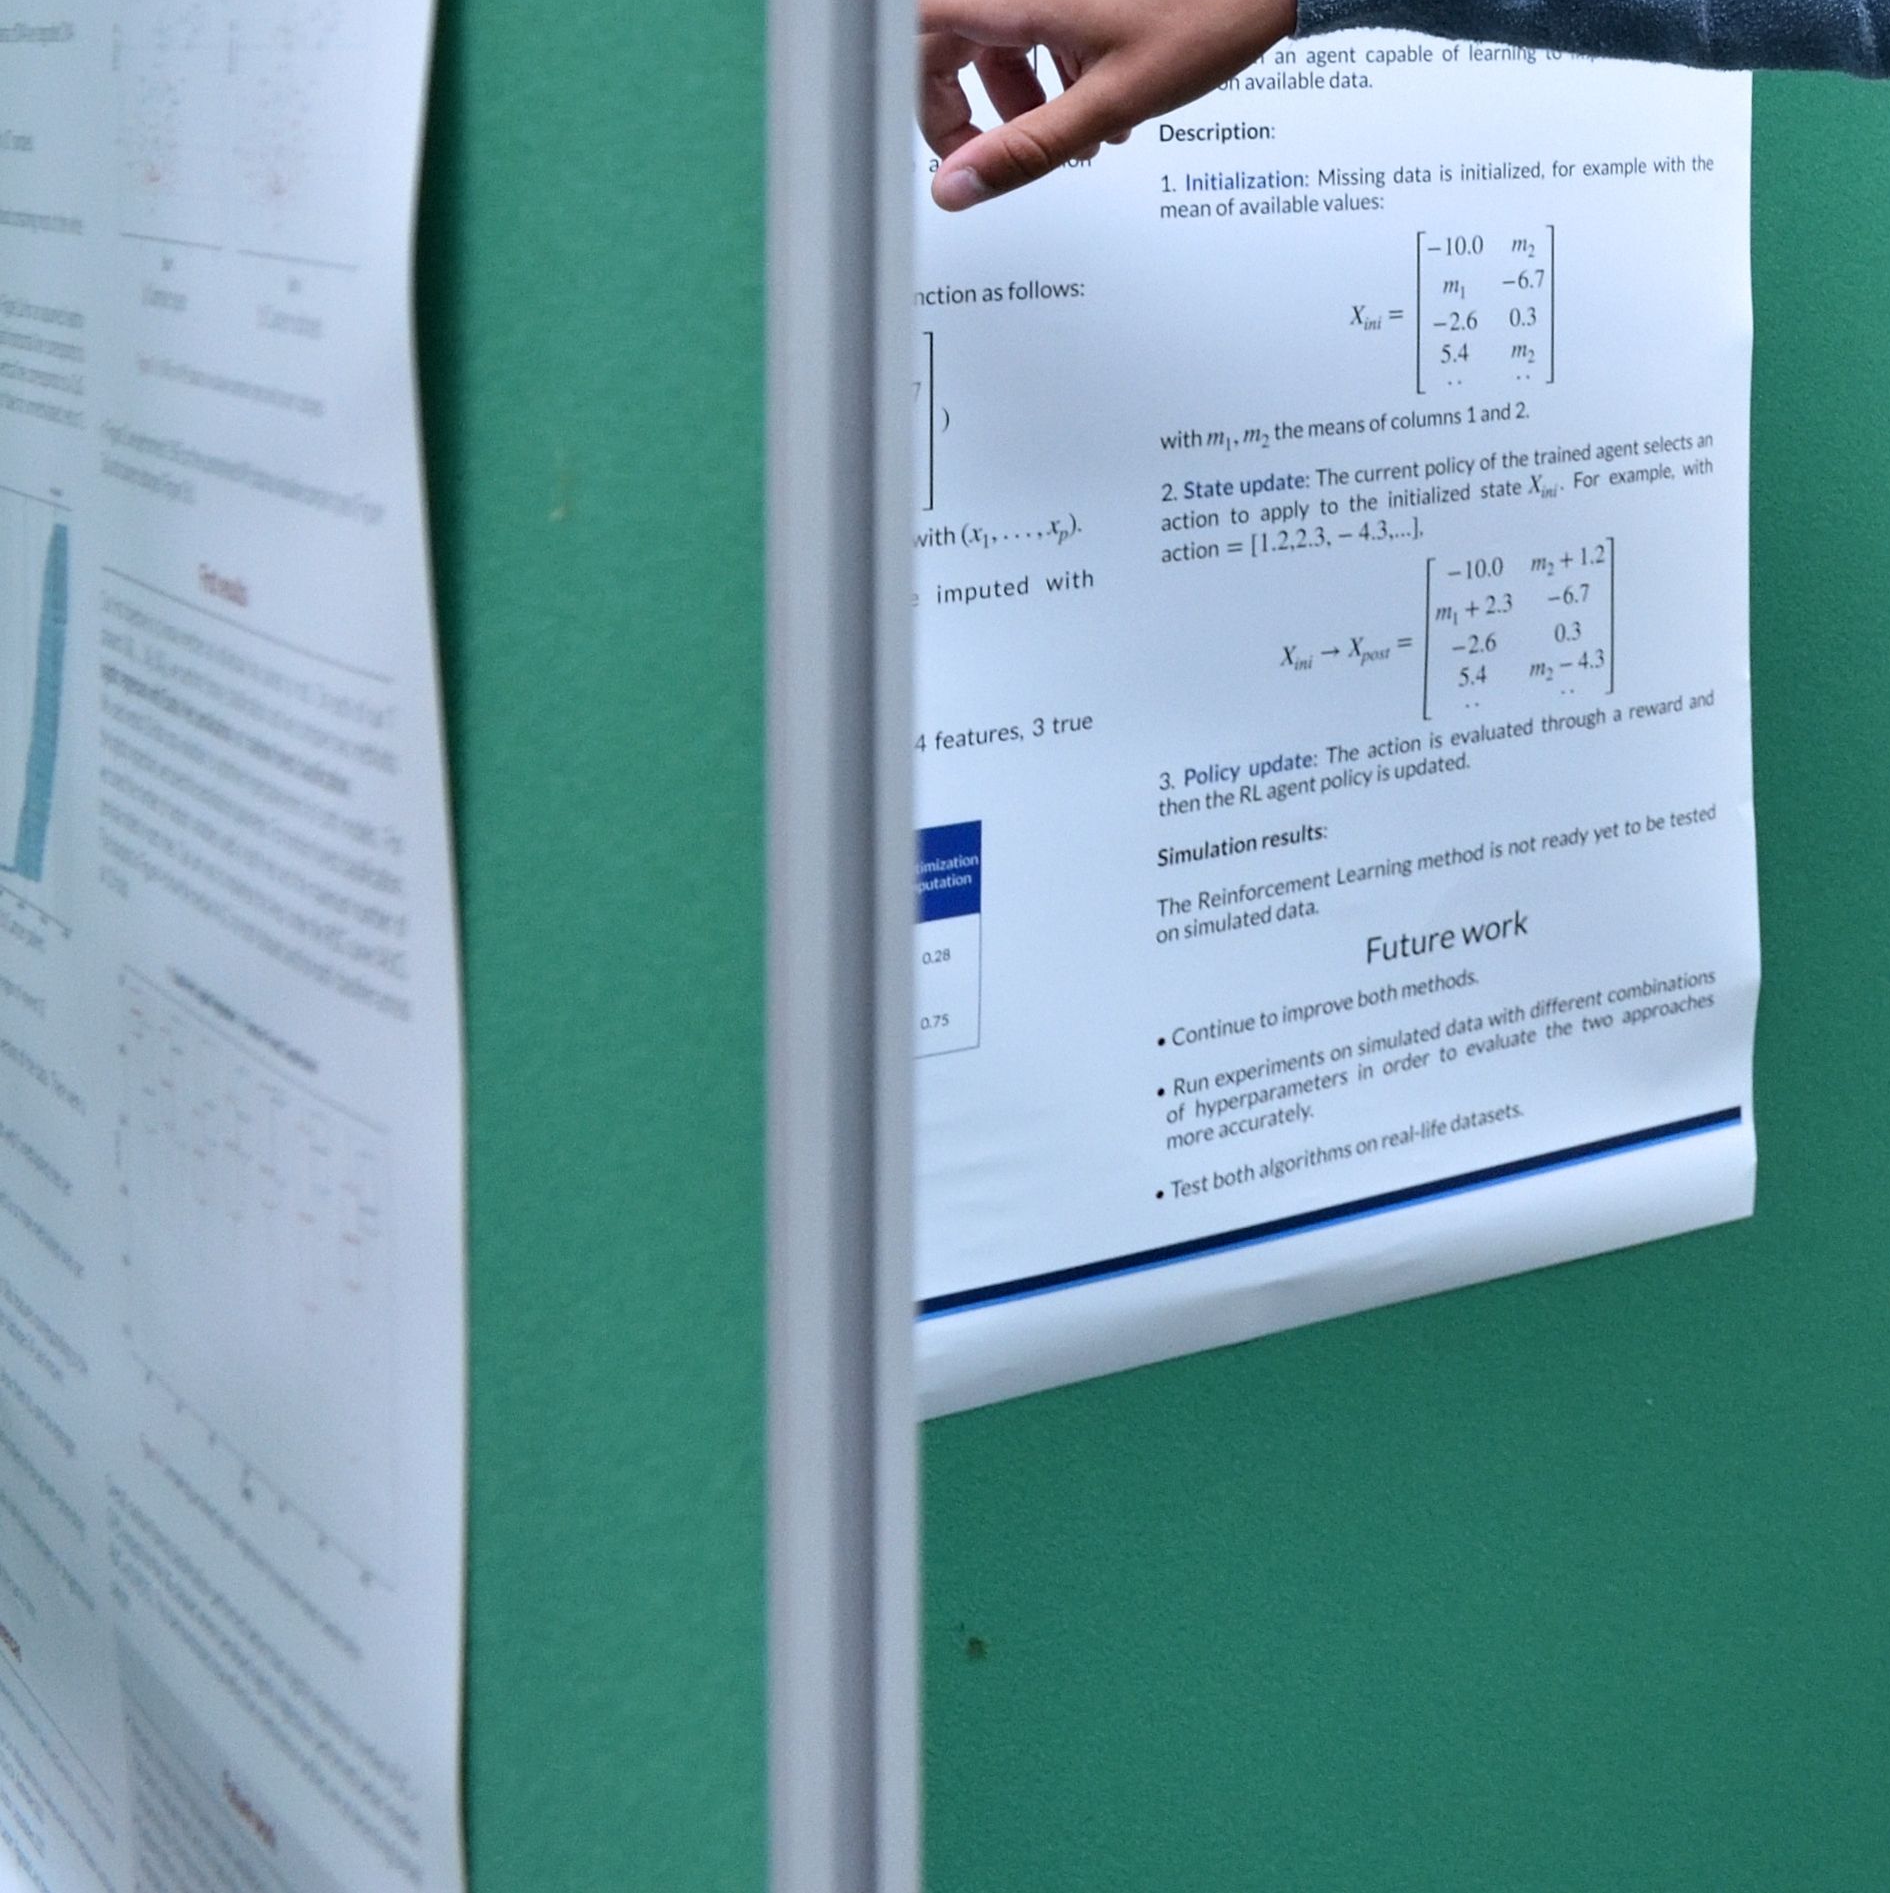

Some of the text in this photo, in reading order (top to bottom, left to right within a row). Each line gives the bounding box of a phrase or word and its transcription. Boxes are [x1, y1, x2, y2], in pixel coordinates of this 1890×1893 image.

[1159, 122, 1275, 144] Description:
[1161, 155, 1714, 193] 1. Initialization: Missing data is initialized, for example with the
[1160, 193, 1384, 219] mean of available values:
[981, 279, 1085, 303] as follows:
[1161, 435, 1713, 502] 2. State update: The current policy of the trained agent selects an
[937, 575, 1029, 605] imputed
[1046, 569, 1094, 592] with
[913, 715, 1093, 752] 4 features, 3 true
[1159, 690, 1714, 791] 3. Policy update: The action is evaluated through a reward and
[1156, 804, 1716, 918] The Reinforcement Learning method is not ready yet to be tested
[1157, 824, 1327, 868] Simulation results:
[1155, 901, 1319, 944] on simulated data.
[1366, 909, 1528, 965] Future work
[1171, 968, 1479, 1047] Continue to improve both methods.
[1170, 1104, 1523, 1199] Test both algorithms on real-life datasets.
